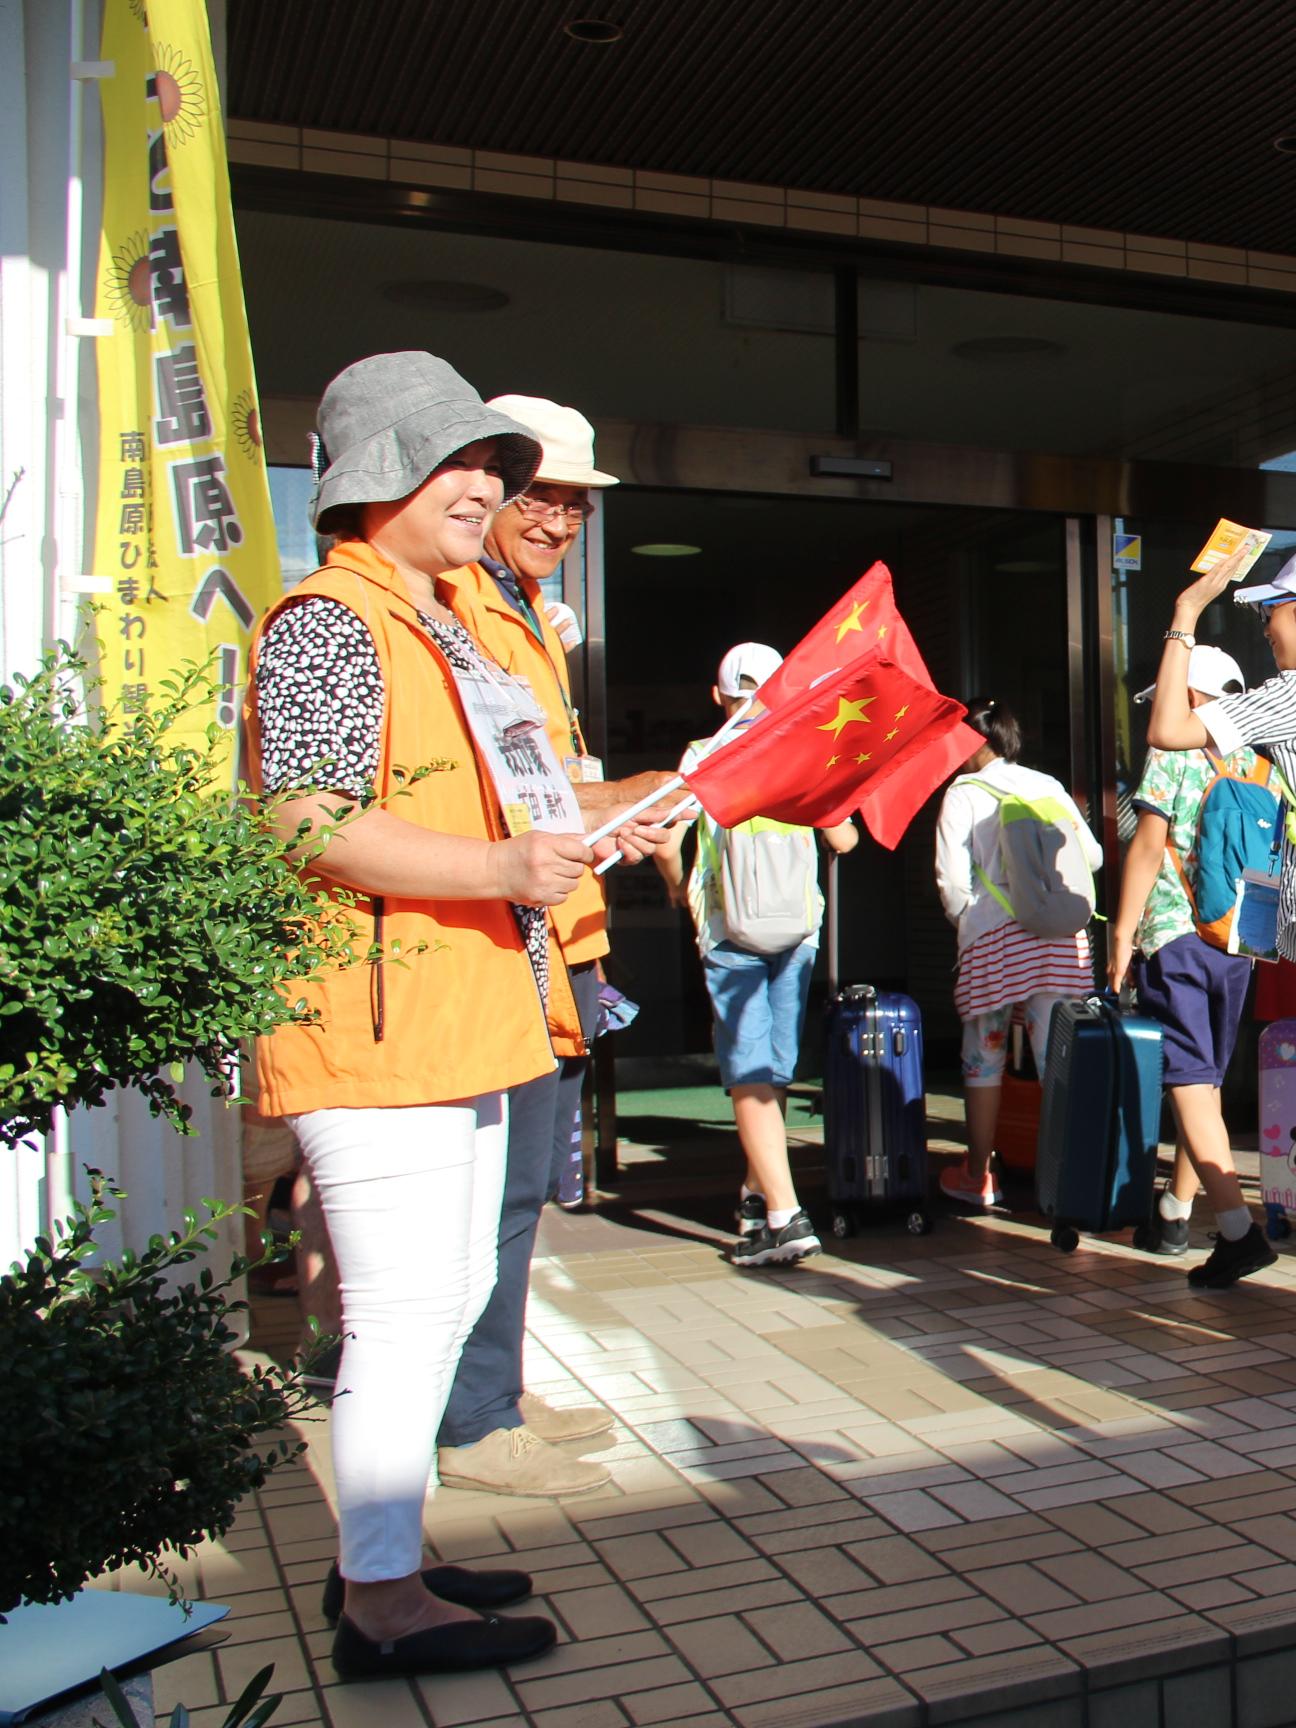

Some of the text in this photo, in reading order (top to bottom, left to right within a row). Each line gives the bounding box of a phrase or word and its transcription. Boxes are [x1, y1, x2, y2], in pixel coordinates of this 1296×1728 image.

[116, 431, 150, 739] 南島原ひまわり観
